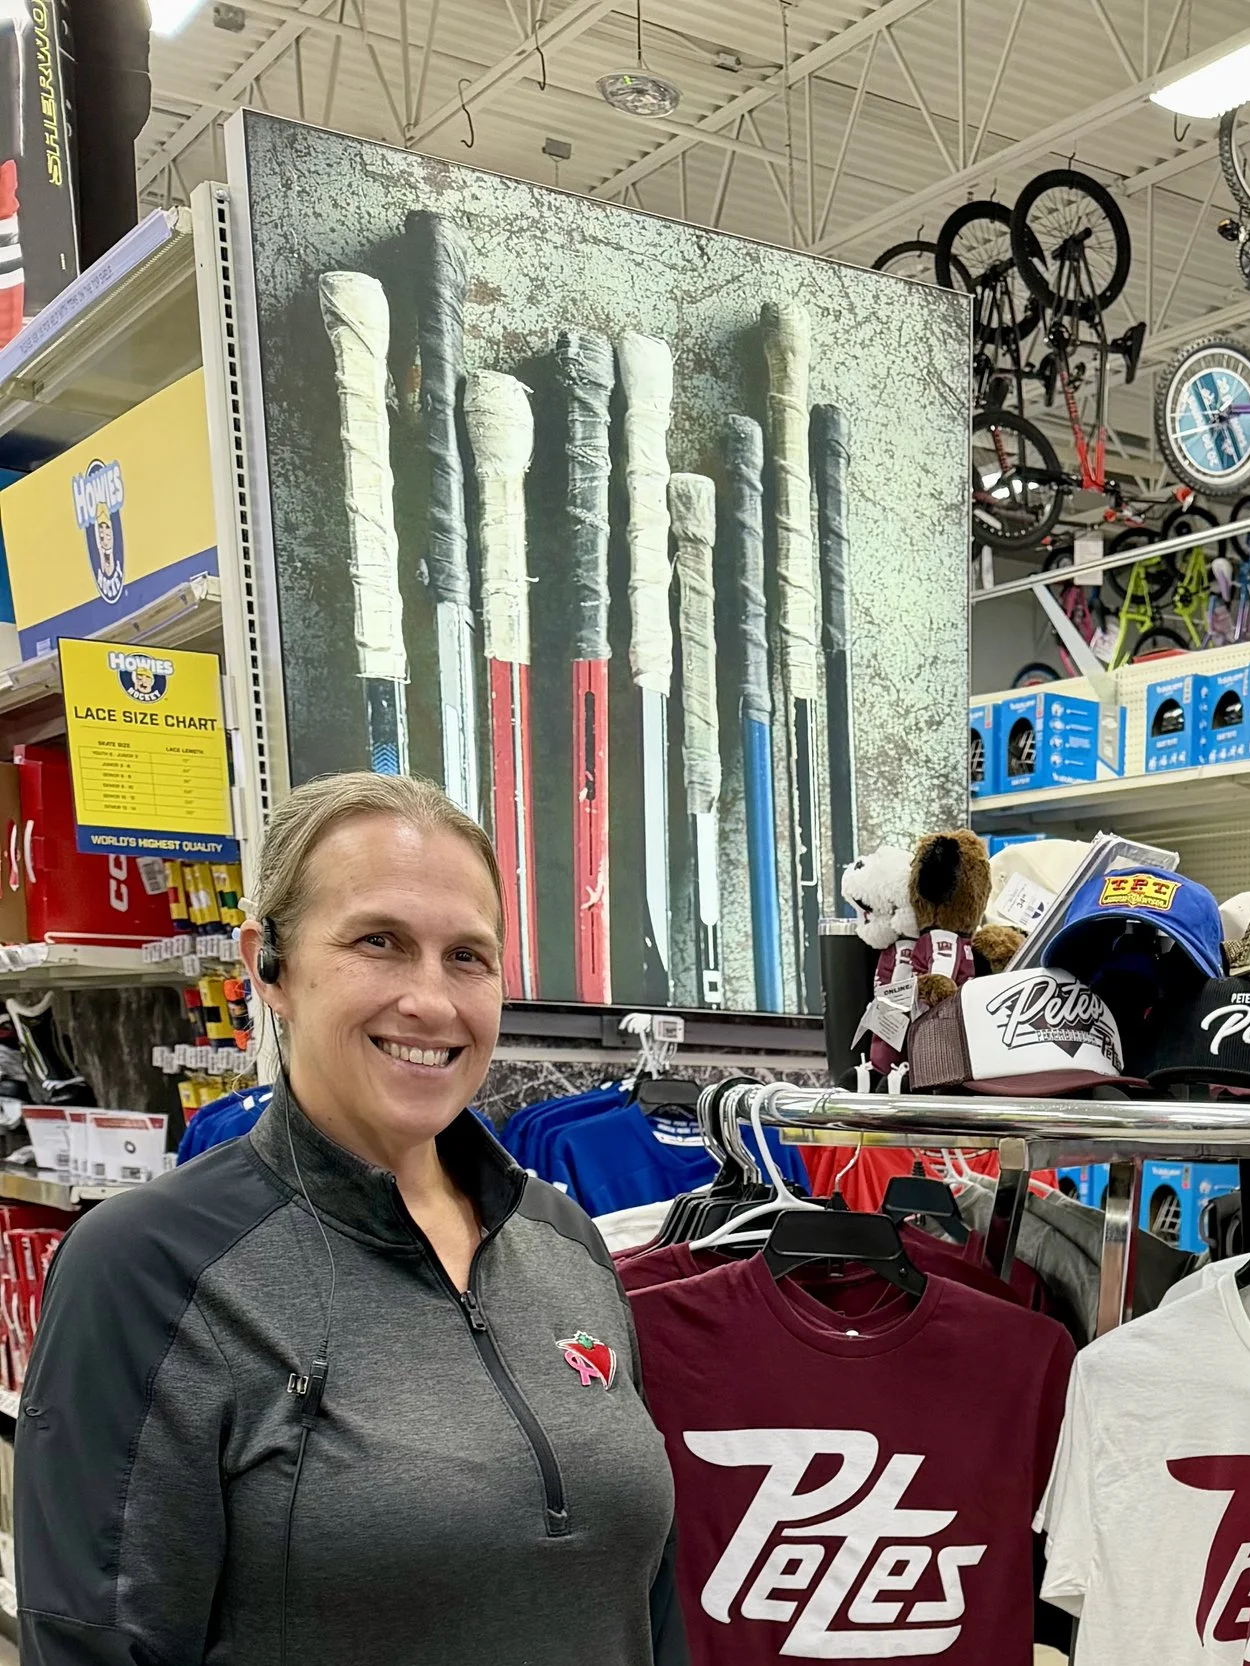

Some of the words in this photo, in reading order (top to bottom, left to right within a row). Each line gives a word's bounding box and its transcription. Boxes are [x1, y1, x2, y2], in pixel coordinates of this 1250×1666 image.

[73, 463, 124, 524] HOWIES
[110, 652, 174, 674] HOWIES
[127, 687, 163, 702] HOCKEY
[74, 706, 117, 722] LACE
[123, 711, 159, 726] SIZE
[165, 715, 217, 731] CHART
[98, 740, 116, 748] SKATE
[91, 835, 136, 848] WORLD'S
[138, 838, 181, 850] HIGHEST
[183, 840, 223, 853] QUALITY
[986, 975, 1105, 1050] Petes
[682, 1428, 988, 1660] Petes
